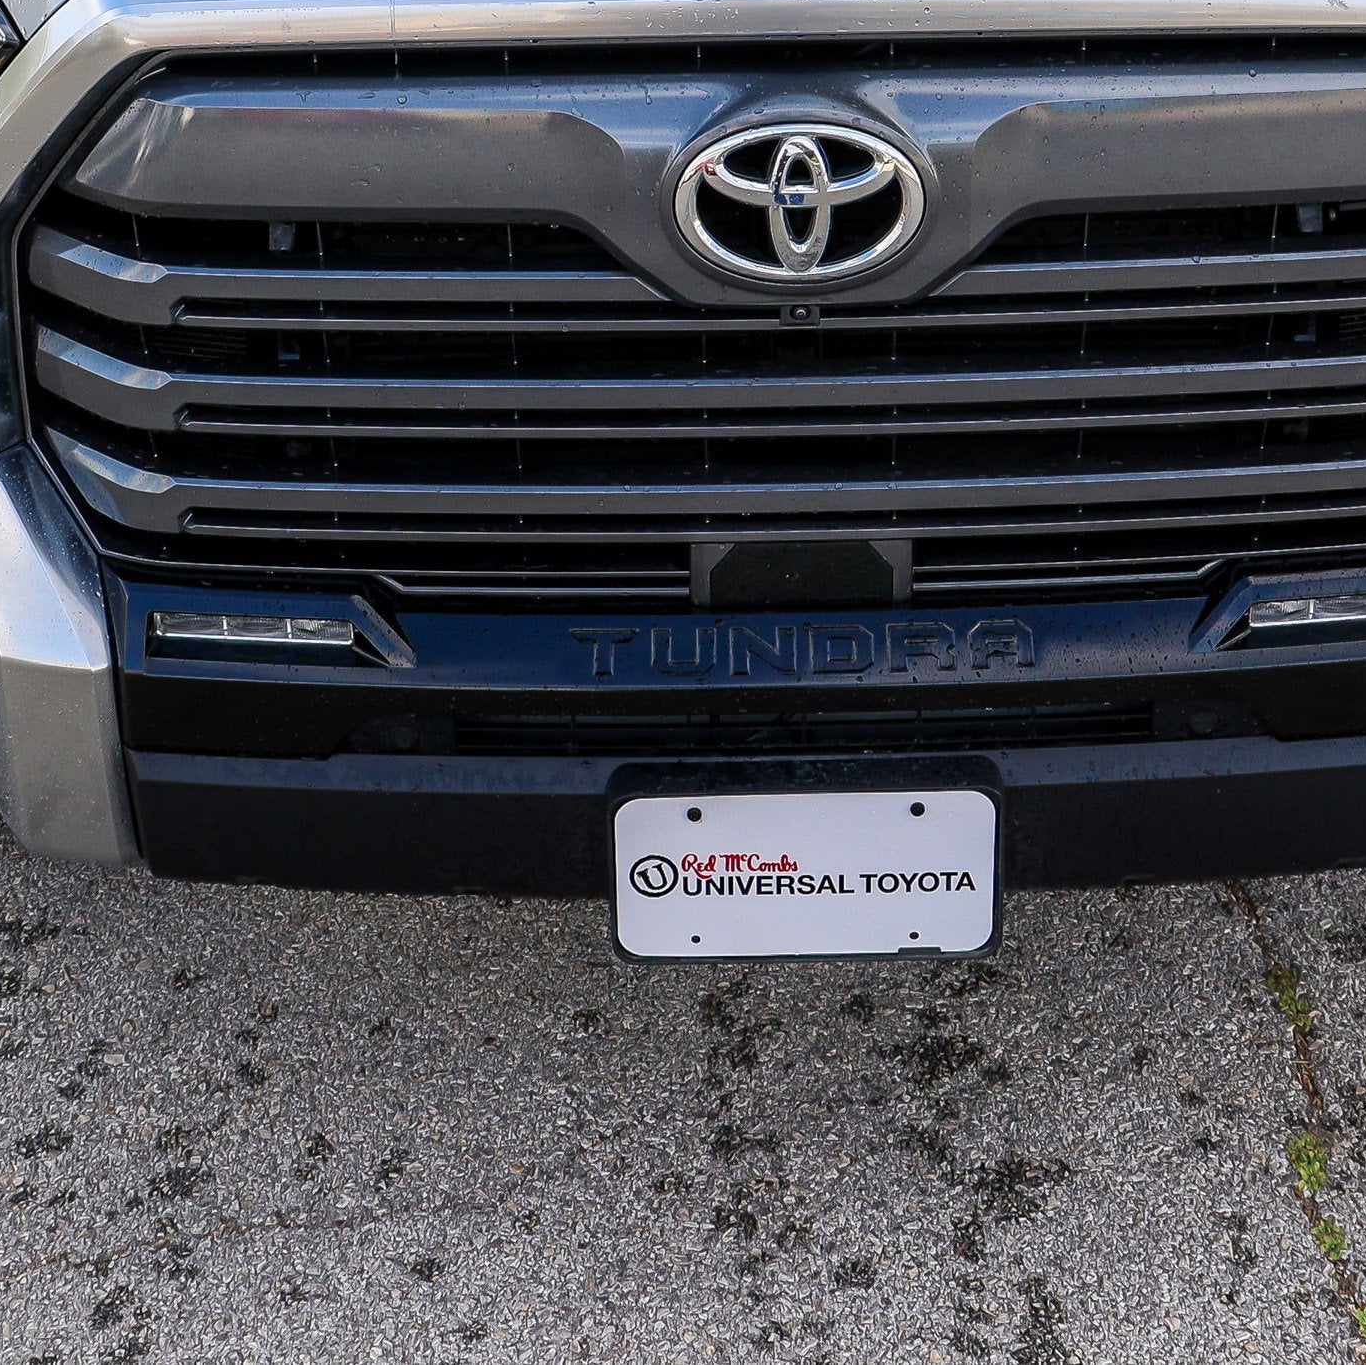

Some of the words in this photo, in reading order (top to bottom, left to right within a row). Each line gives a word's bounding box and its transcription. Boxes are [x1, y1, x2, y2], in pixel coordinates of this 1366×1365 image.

[569, 619, 1035, 677] TUNDRA
[681, 853, 716, 879] Red
[719, 853, 798, 872] McCombs
[682, 873, 855, 896] UNIVERSAL
[859, 871, 976, 894] TOYOTA
